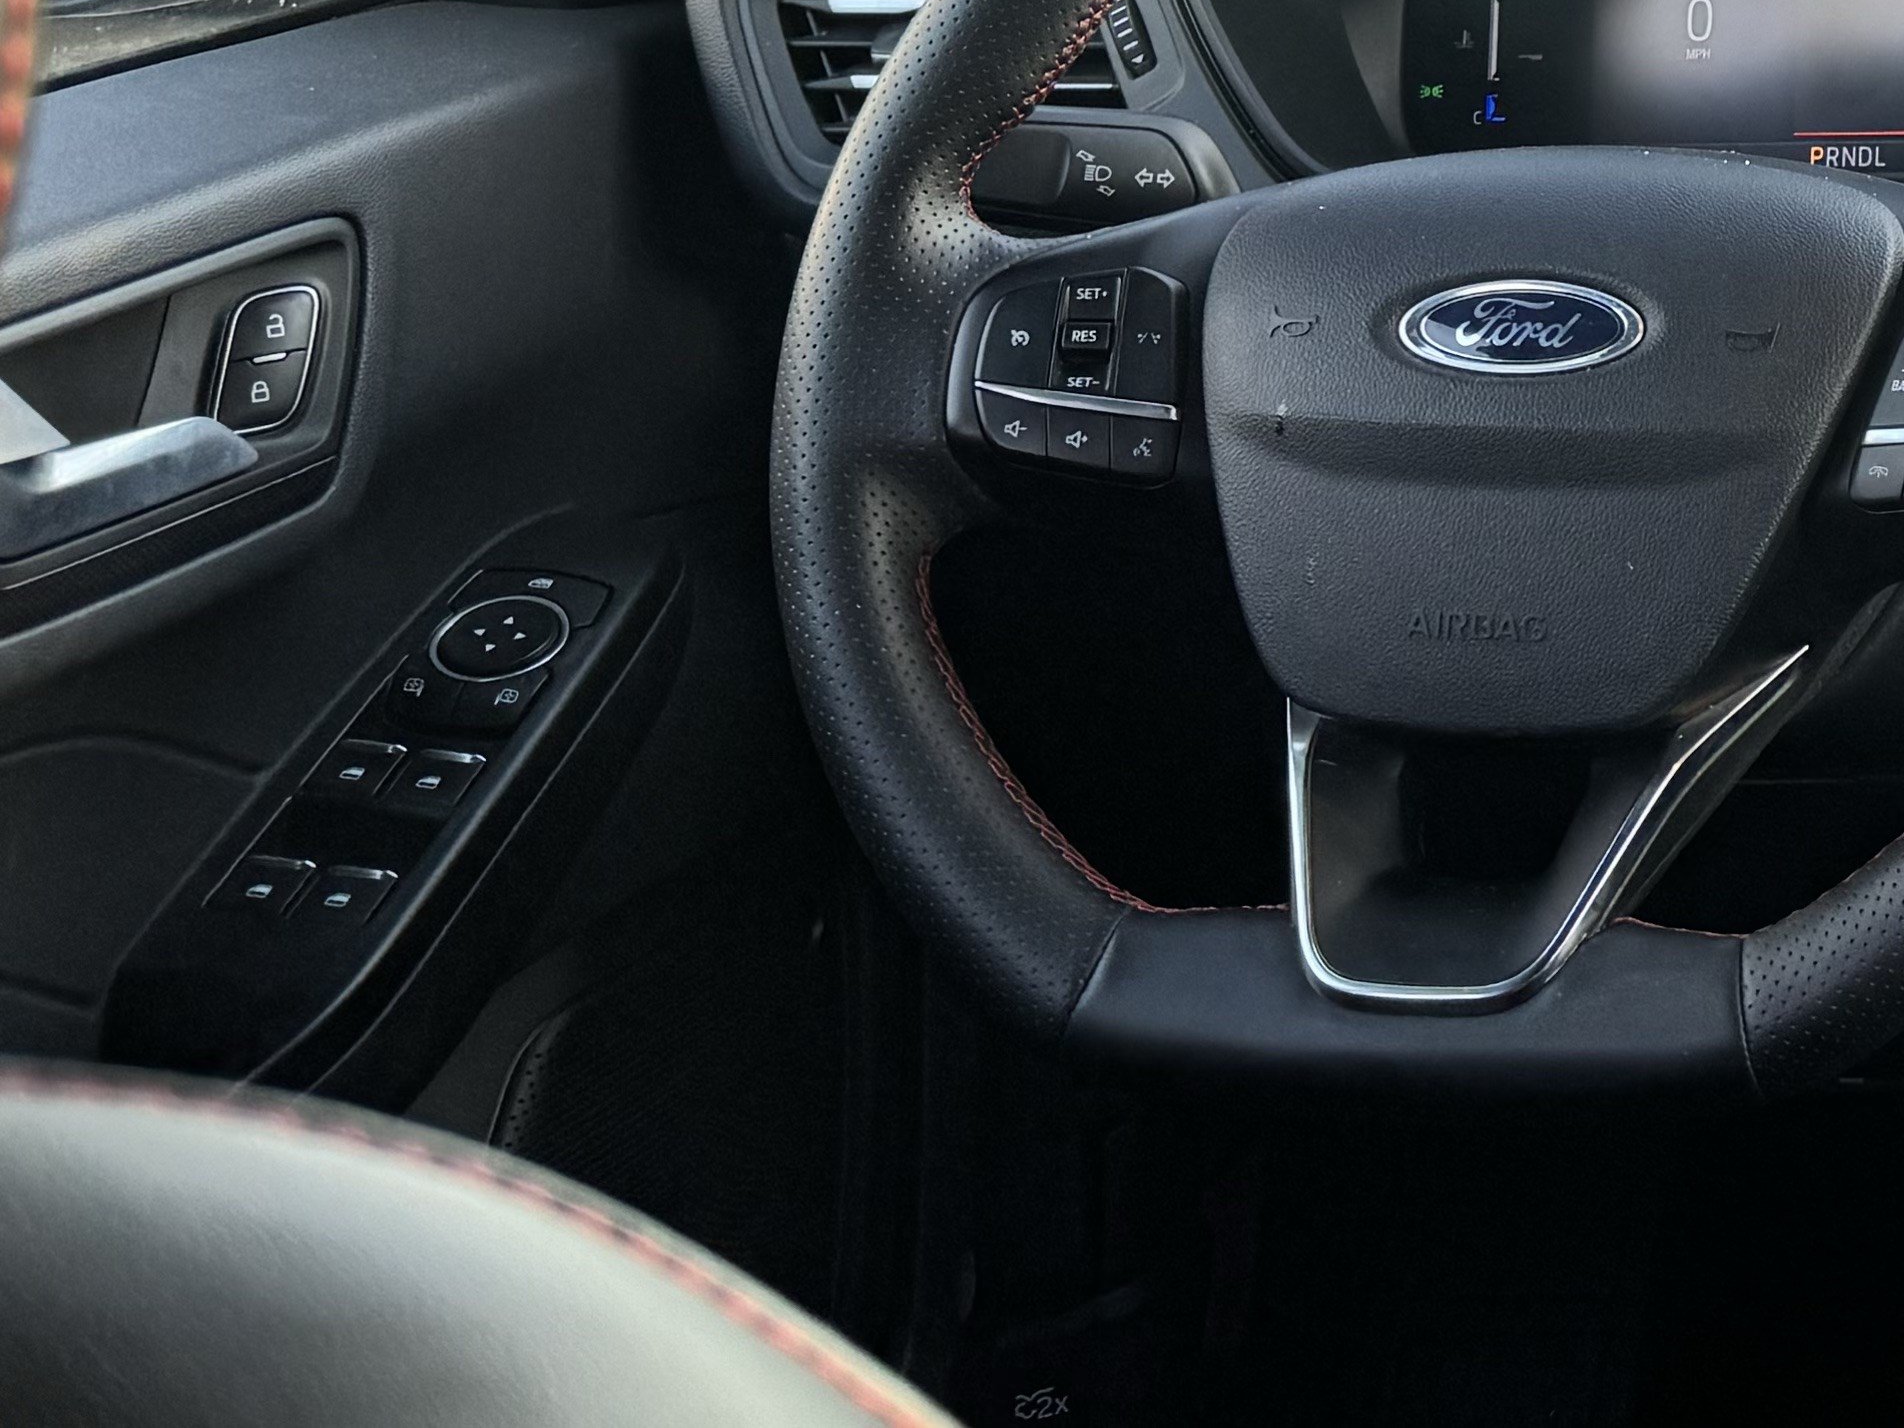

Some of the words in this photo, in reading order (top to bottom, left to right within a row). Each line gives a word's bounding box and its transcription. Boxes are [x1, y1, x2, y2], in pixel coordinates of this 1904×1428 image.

[1684, 47, 1712, 61] MPH
[1809, 145, 1886, 168] PRNDL
[1454, 295, 1583, 350] Ford
[1071, 329, 1098, 343] RES
[1406, 609, 1549, 643] AIRBAG
